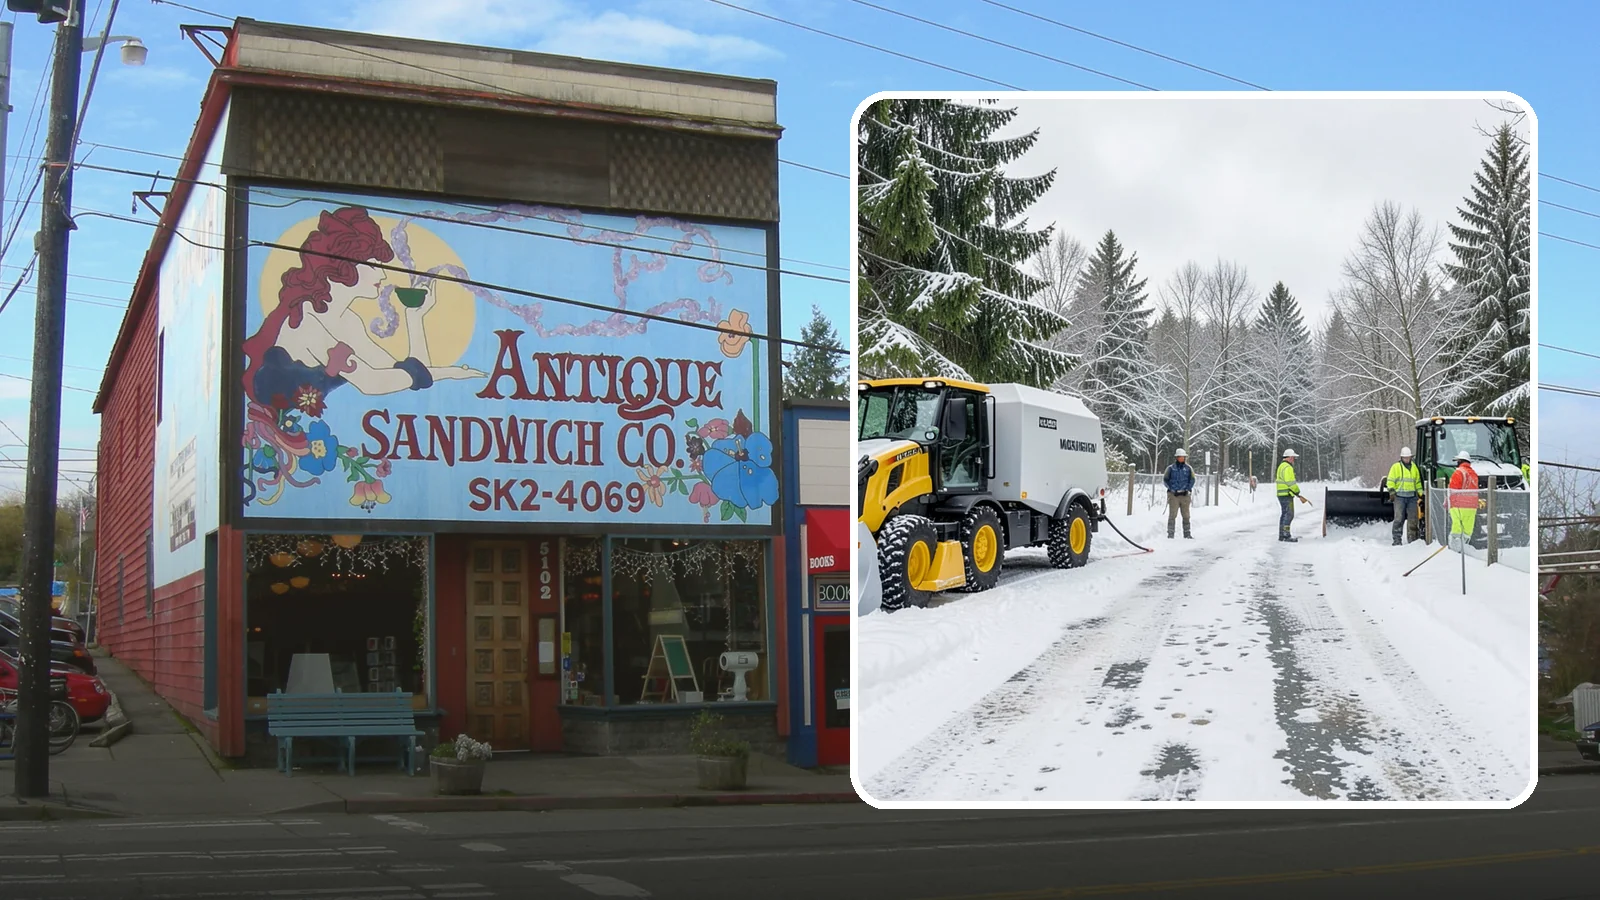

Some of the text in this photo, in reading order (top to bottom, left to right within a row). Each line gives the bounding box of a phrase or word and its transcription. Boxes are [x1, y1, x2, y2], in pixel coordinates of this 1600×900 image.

[476, 329, 723, 421] ANTIQUE
[361, 408, 685, 469] SANDWICH CO.
[468, 477, 645, 514] SK2-4069
[540, 541, 551, 600] 5102
[809, 554, 835, 569] BOOKS
